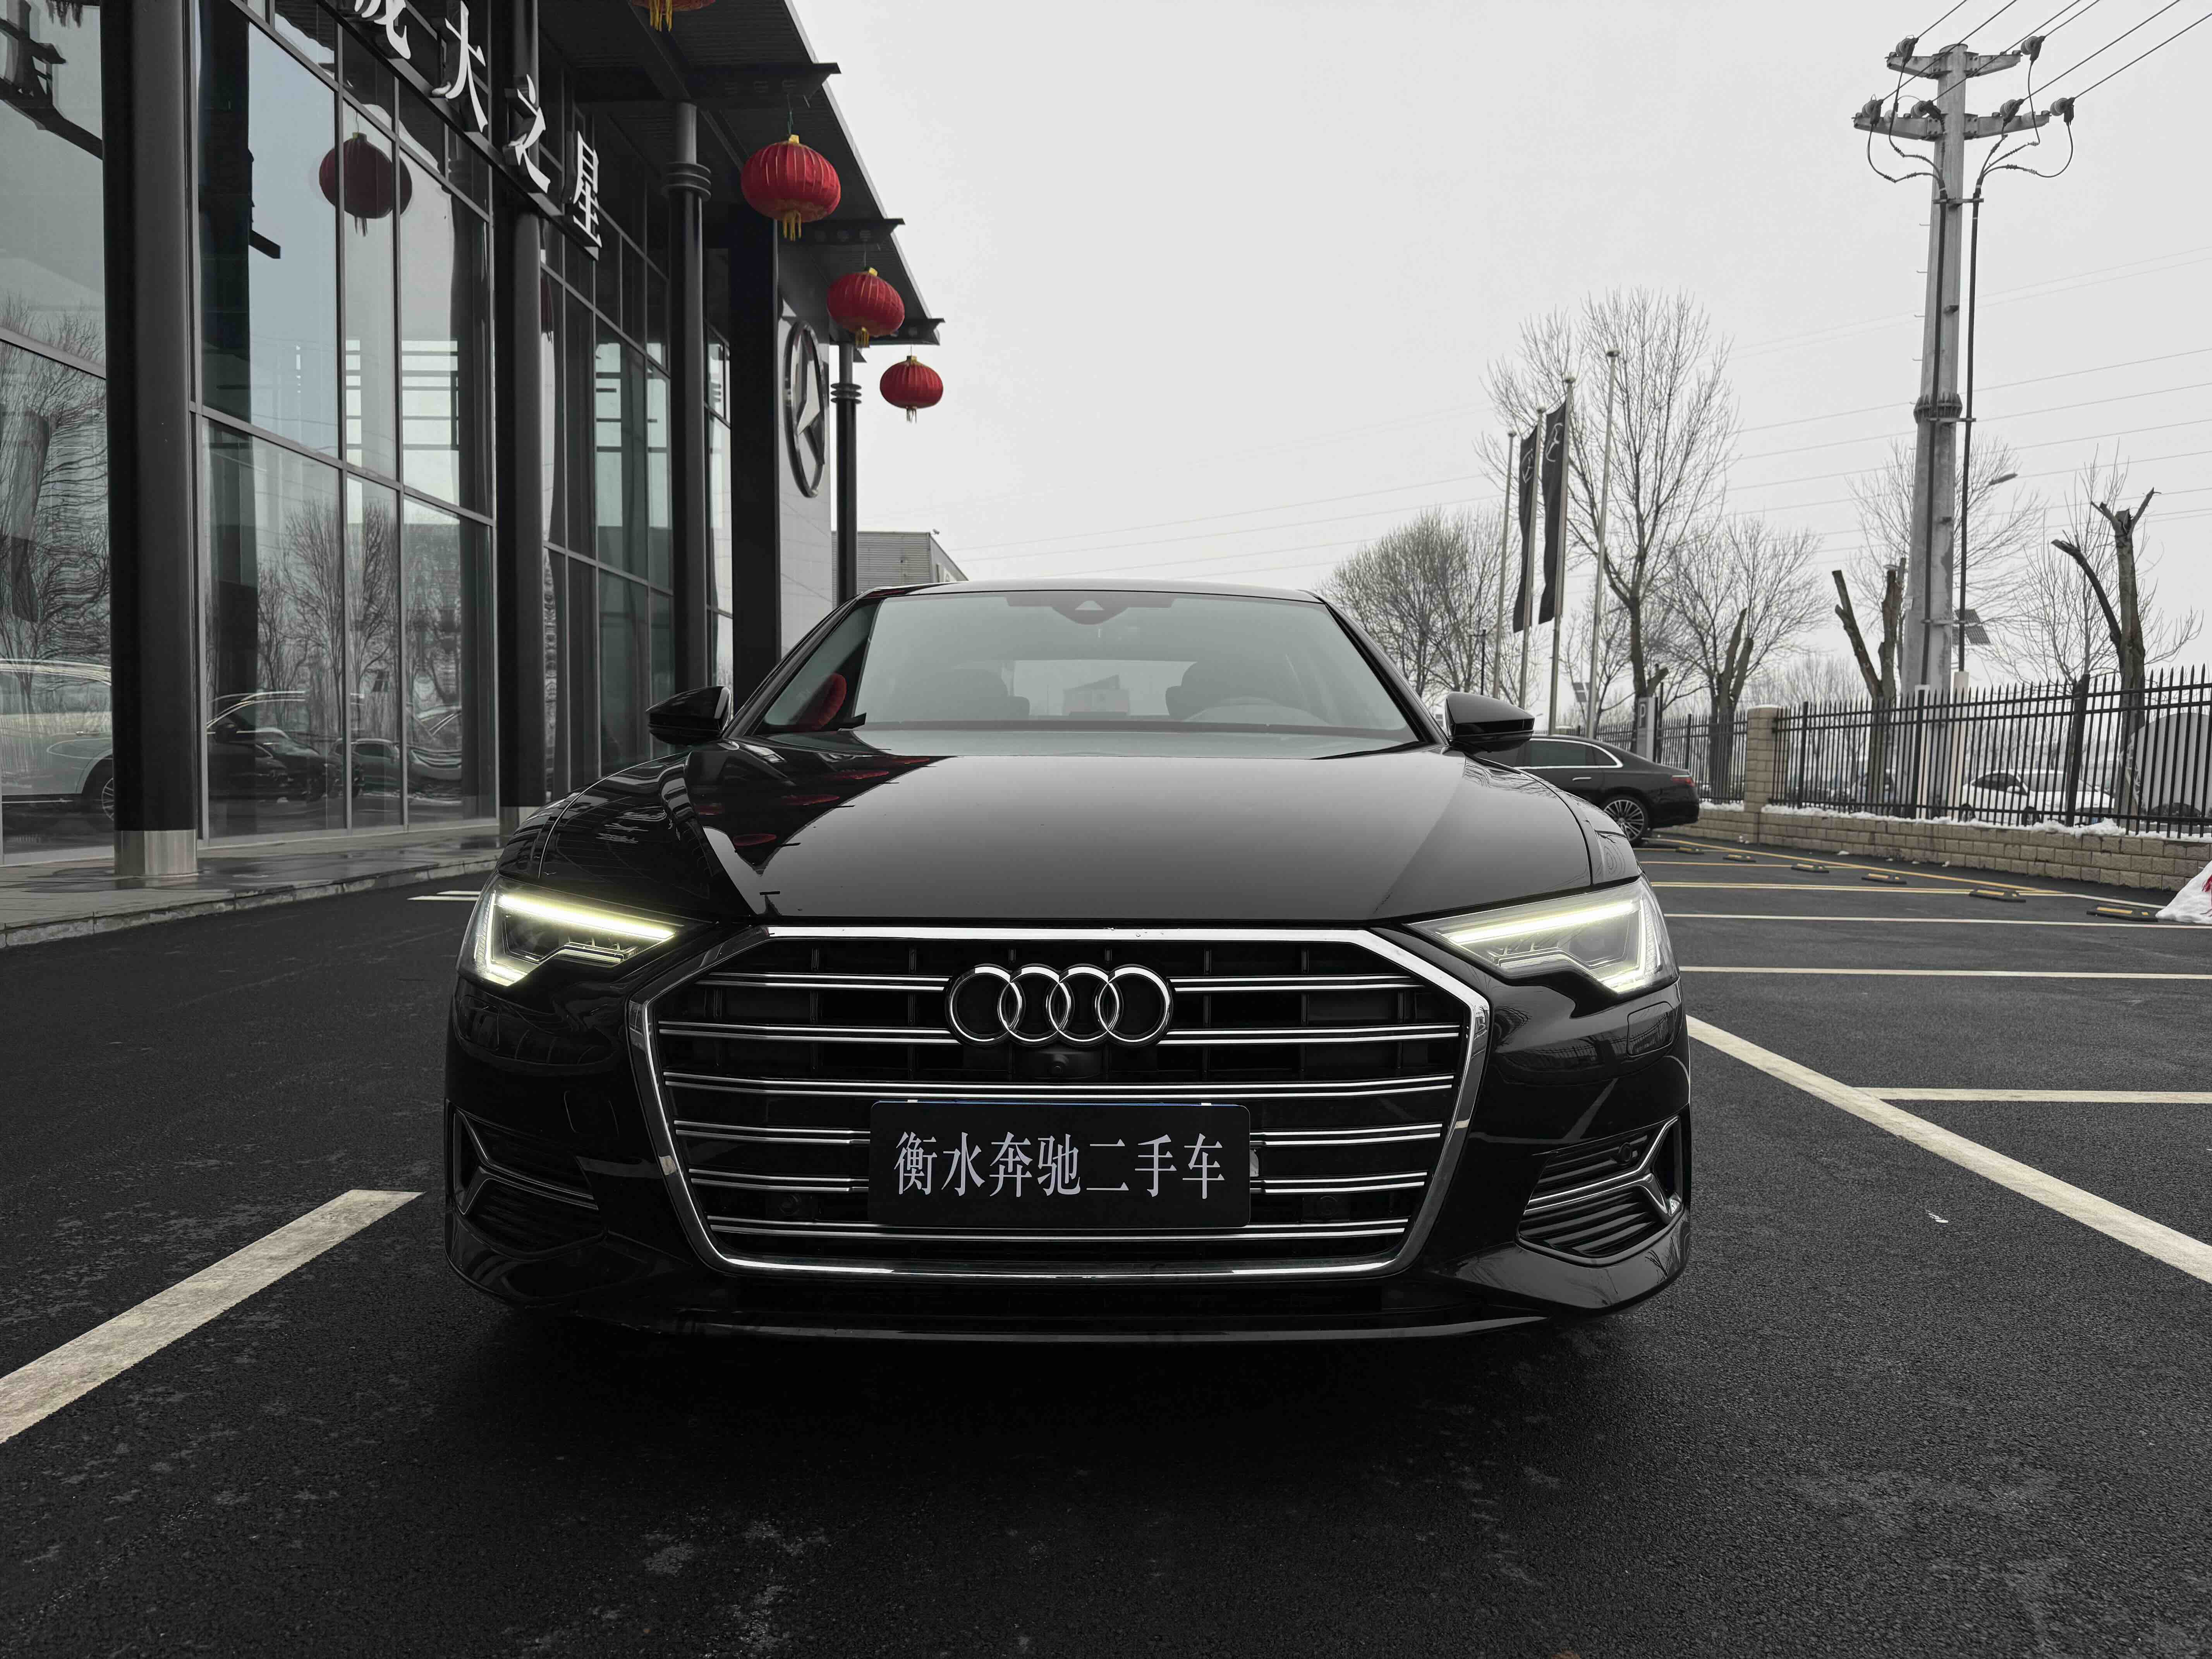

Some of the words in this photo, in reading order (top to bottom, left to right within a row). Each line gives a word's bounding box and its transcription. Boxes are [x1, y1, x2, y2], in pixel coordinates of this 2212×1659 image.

[1639, 703, 1645, 727] P
[894, 1131, 1225, 1199] 衡水奔驰二手车
